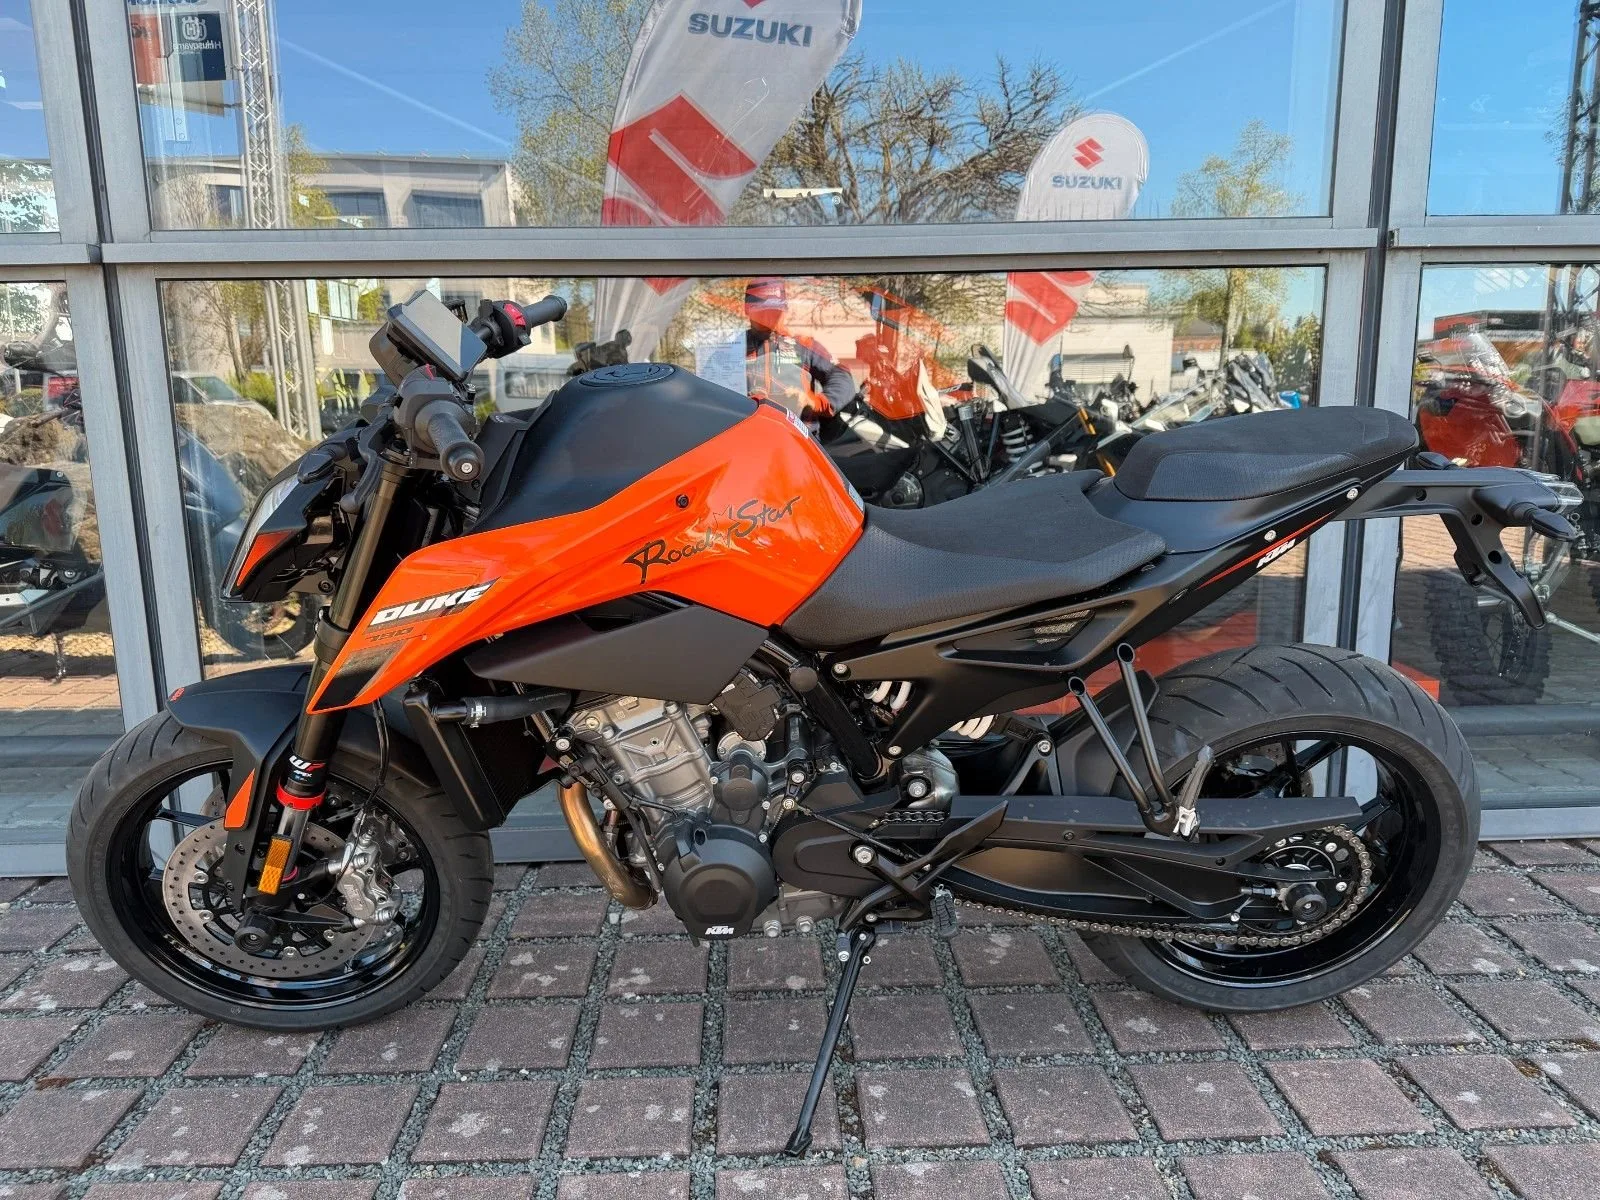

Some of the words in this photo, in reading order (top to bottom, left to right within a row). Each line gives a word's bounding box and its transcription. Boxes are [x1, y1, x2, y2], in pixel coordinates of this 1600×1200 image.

[687, 12, 813, 47] SUZUKI
[1052, 174, 1122, 190] SUZUKI
[370, 583, 492, 626] DUKE
[289, 755, 326, 772] WP
[704, 925, 735, 935] KTM
